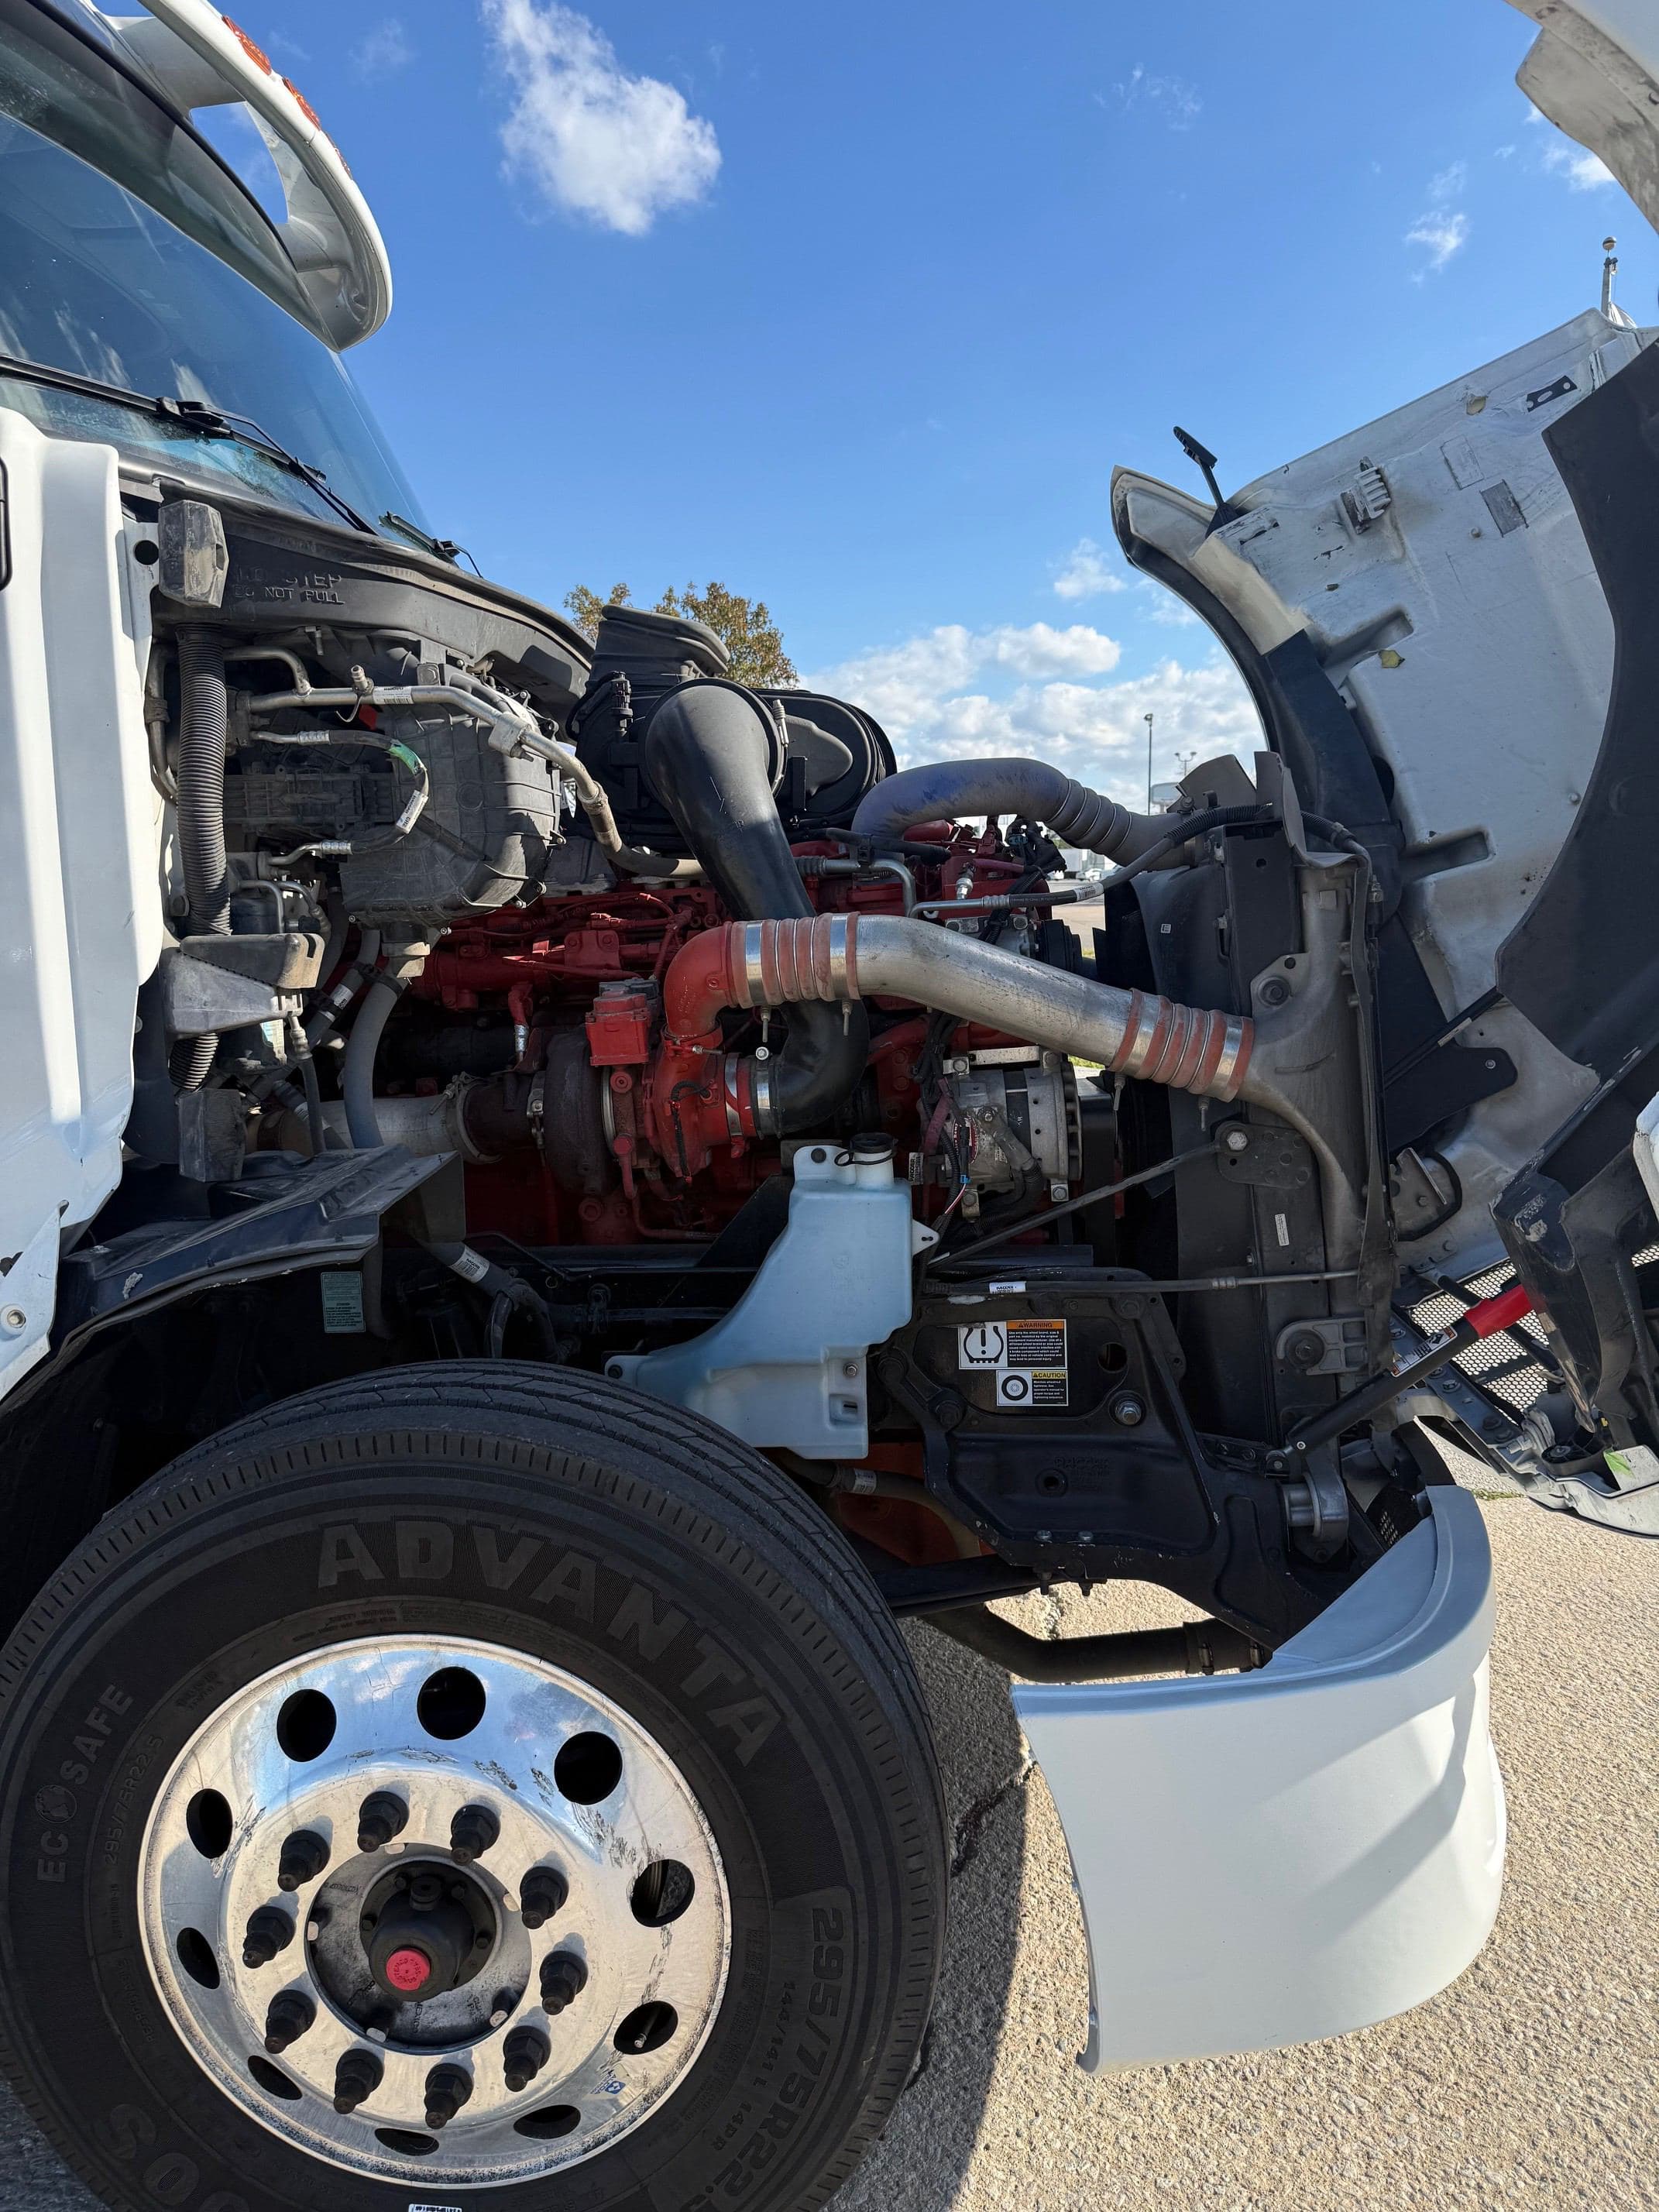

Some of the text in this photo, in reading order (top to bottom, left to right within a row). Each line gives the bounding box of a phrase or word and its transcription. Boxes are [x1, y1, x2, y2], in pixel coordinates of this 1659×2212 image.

[265, 587, 295, 599] NOT
[304, 589, 345, 605] PULL
[317, 1517, 781, 1767] ADVANTA
[60, 1684, 135, 1785] SAFE
